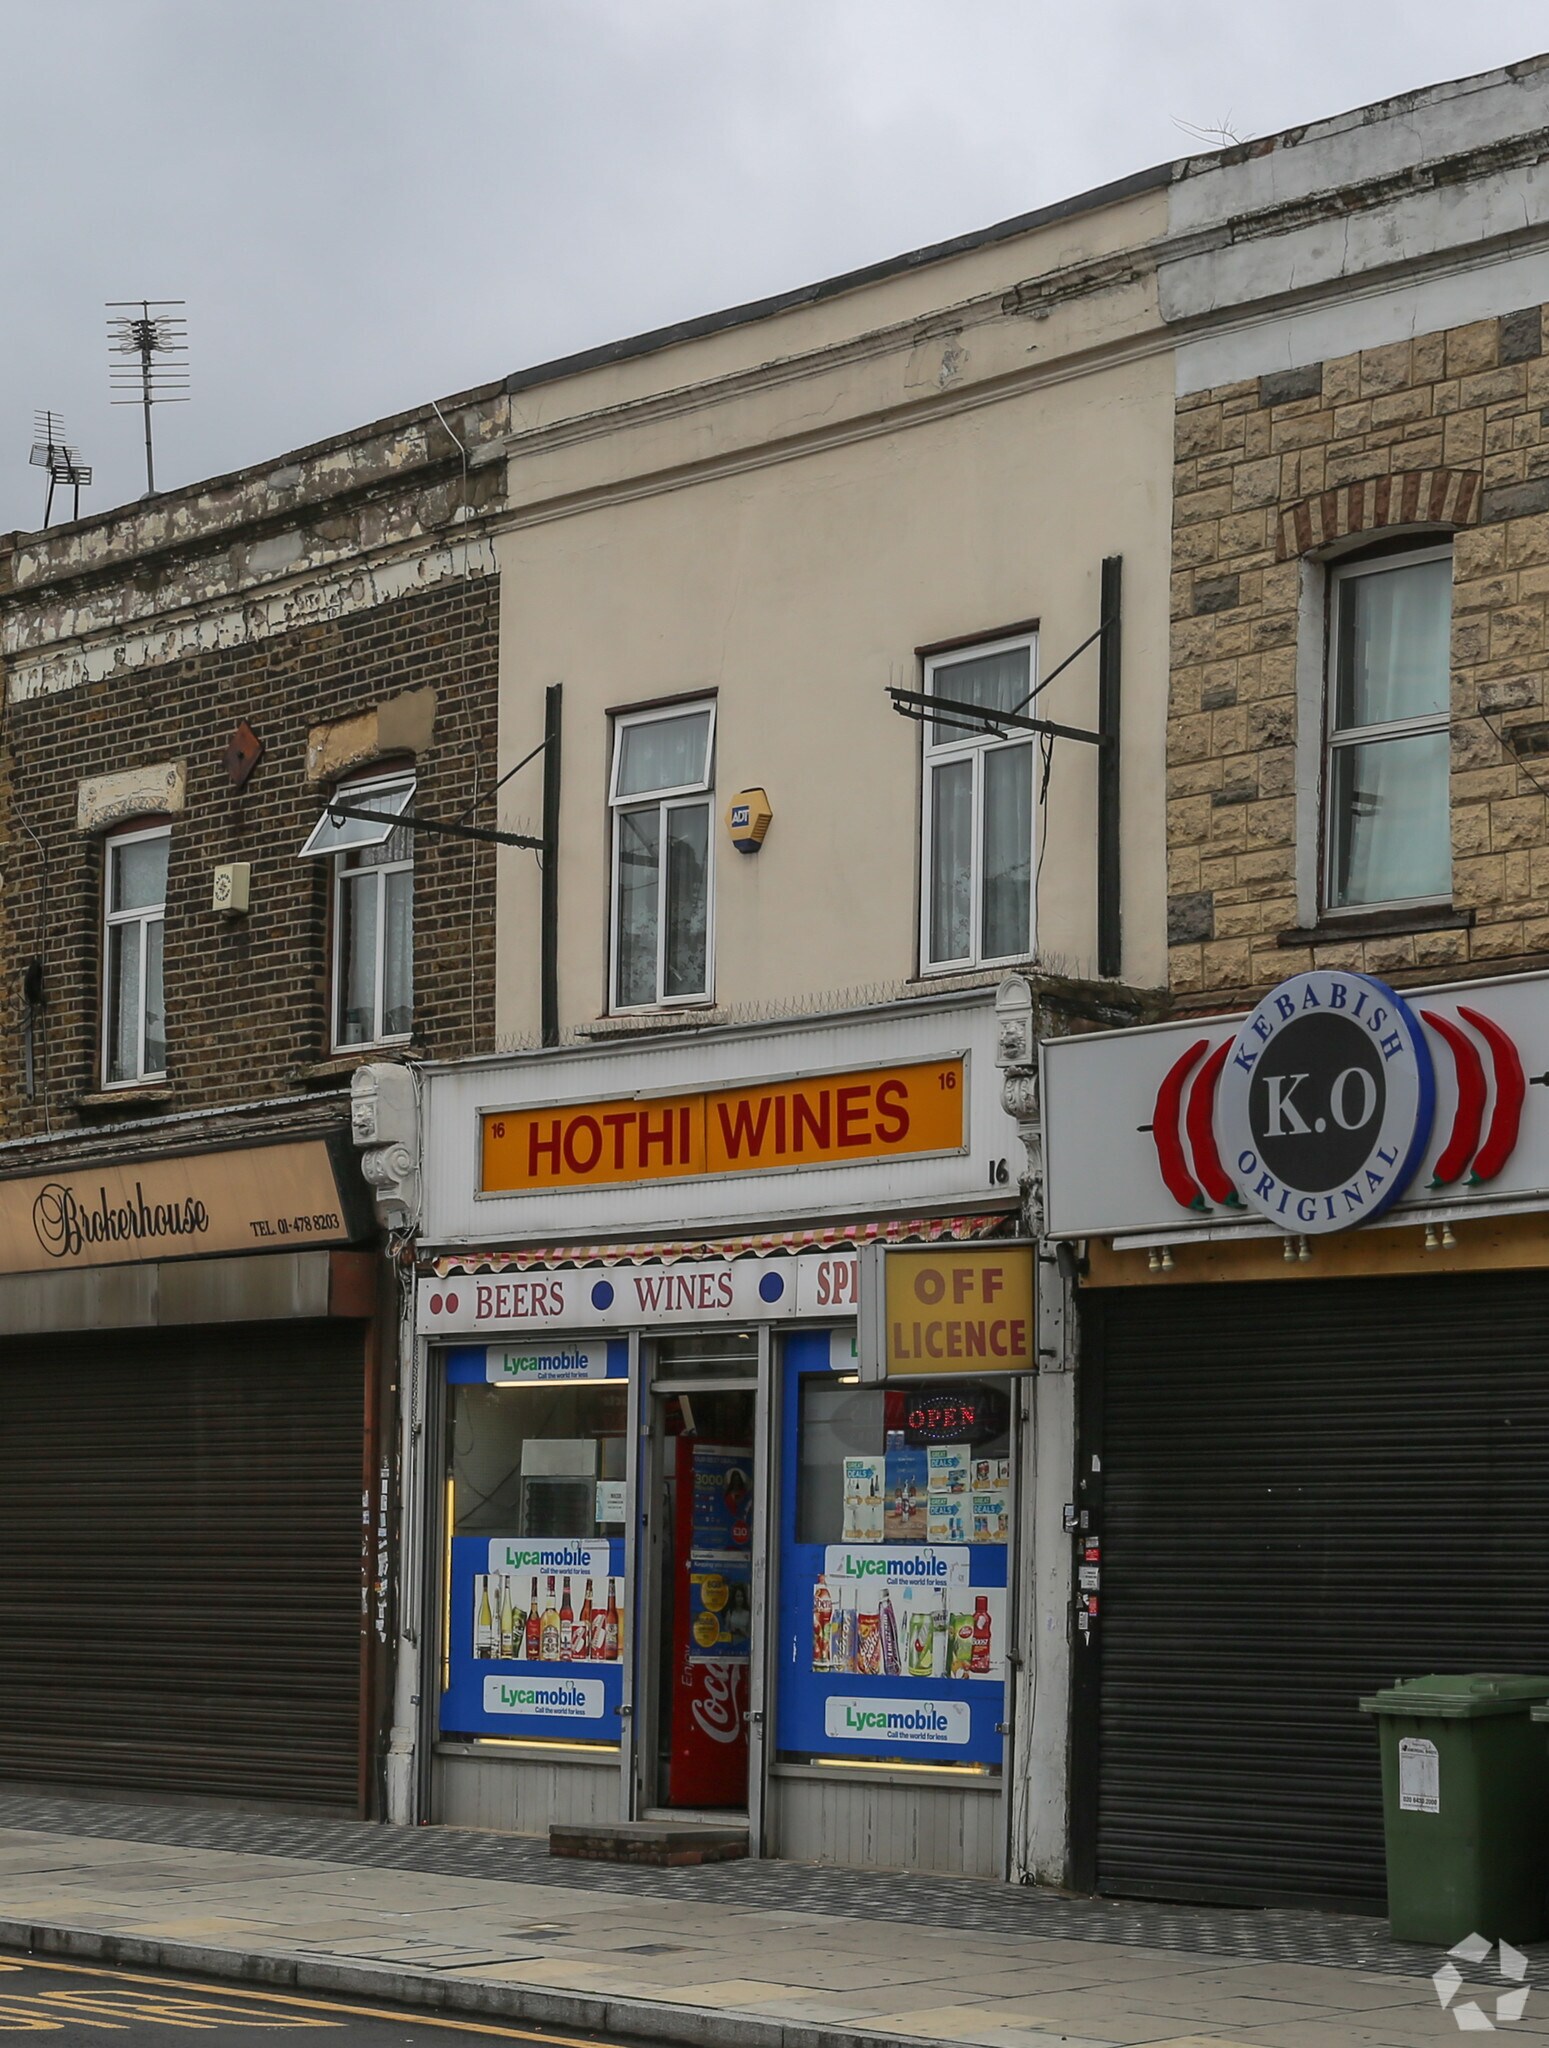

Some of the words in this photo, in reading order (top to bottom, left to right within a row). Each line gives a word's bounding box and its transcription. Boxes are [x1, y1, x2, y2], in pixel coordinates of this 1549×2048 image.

[732, 810, 750, 824] ADT
[1233, 983, 1404, 1075] KEBABISH
[939, 1072, 956, 1090] 16
[1262, 1066, 1377, 1137] K.O
[491, 1122, 505, 1140] 16
[528, 1107, 691, 1177] HOTHI
[718, 1080, 909, 1160] WINES
[989, 1158, 1008, 1185] 16
[1238, 1145, 1398, 1222] ORIGINAL
[33, 1182, 209, 1257] Brokerhouse
[250, 1220, 277, 1237] TEL.
[313, 1213, 340, 1232] 8203
[475, 1282, 565, 1320] BEERS
[634, 1272, 733, 1312] WINES
[914, 1268, 1003, 1305] OFF
[893, 1319, 1027, 1359] LICENCE
[503, 1351, 588, 1375] Lycamobile
[557, 1371, 570, 1379] world
[908, 1406, 976, 1429] OPEN
[847, 1469, 867, 1478] DEALS
[931, 1458, 952, 1467] DEALS
[930, 1505, 952, 1515] DEALS
[973, 1505, 995, 1514] DEALS
[506, 1547, 591, 1569] Lycamobile
[846, 1555, 947, 1579] Lycamobile
[910, 1578, 925, 1586] world
[501, 1685, 586, 1707] Lycamobile
[554, 1707, 567, 1715] world
[846, 1707, 948, 1731] Lycamobile
[910, 1732, 926, 1740] world
